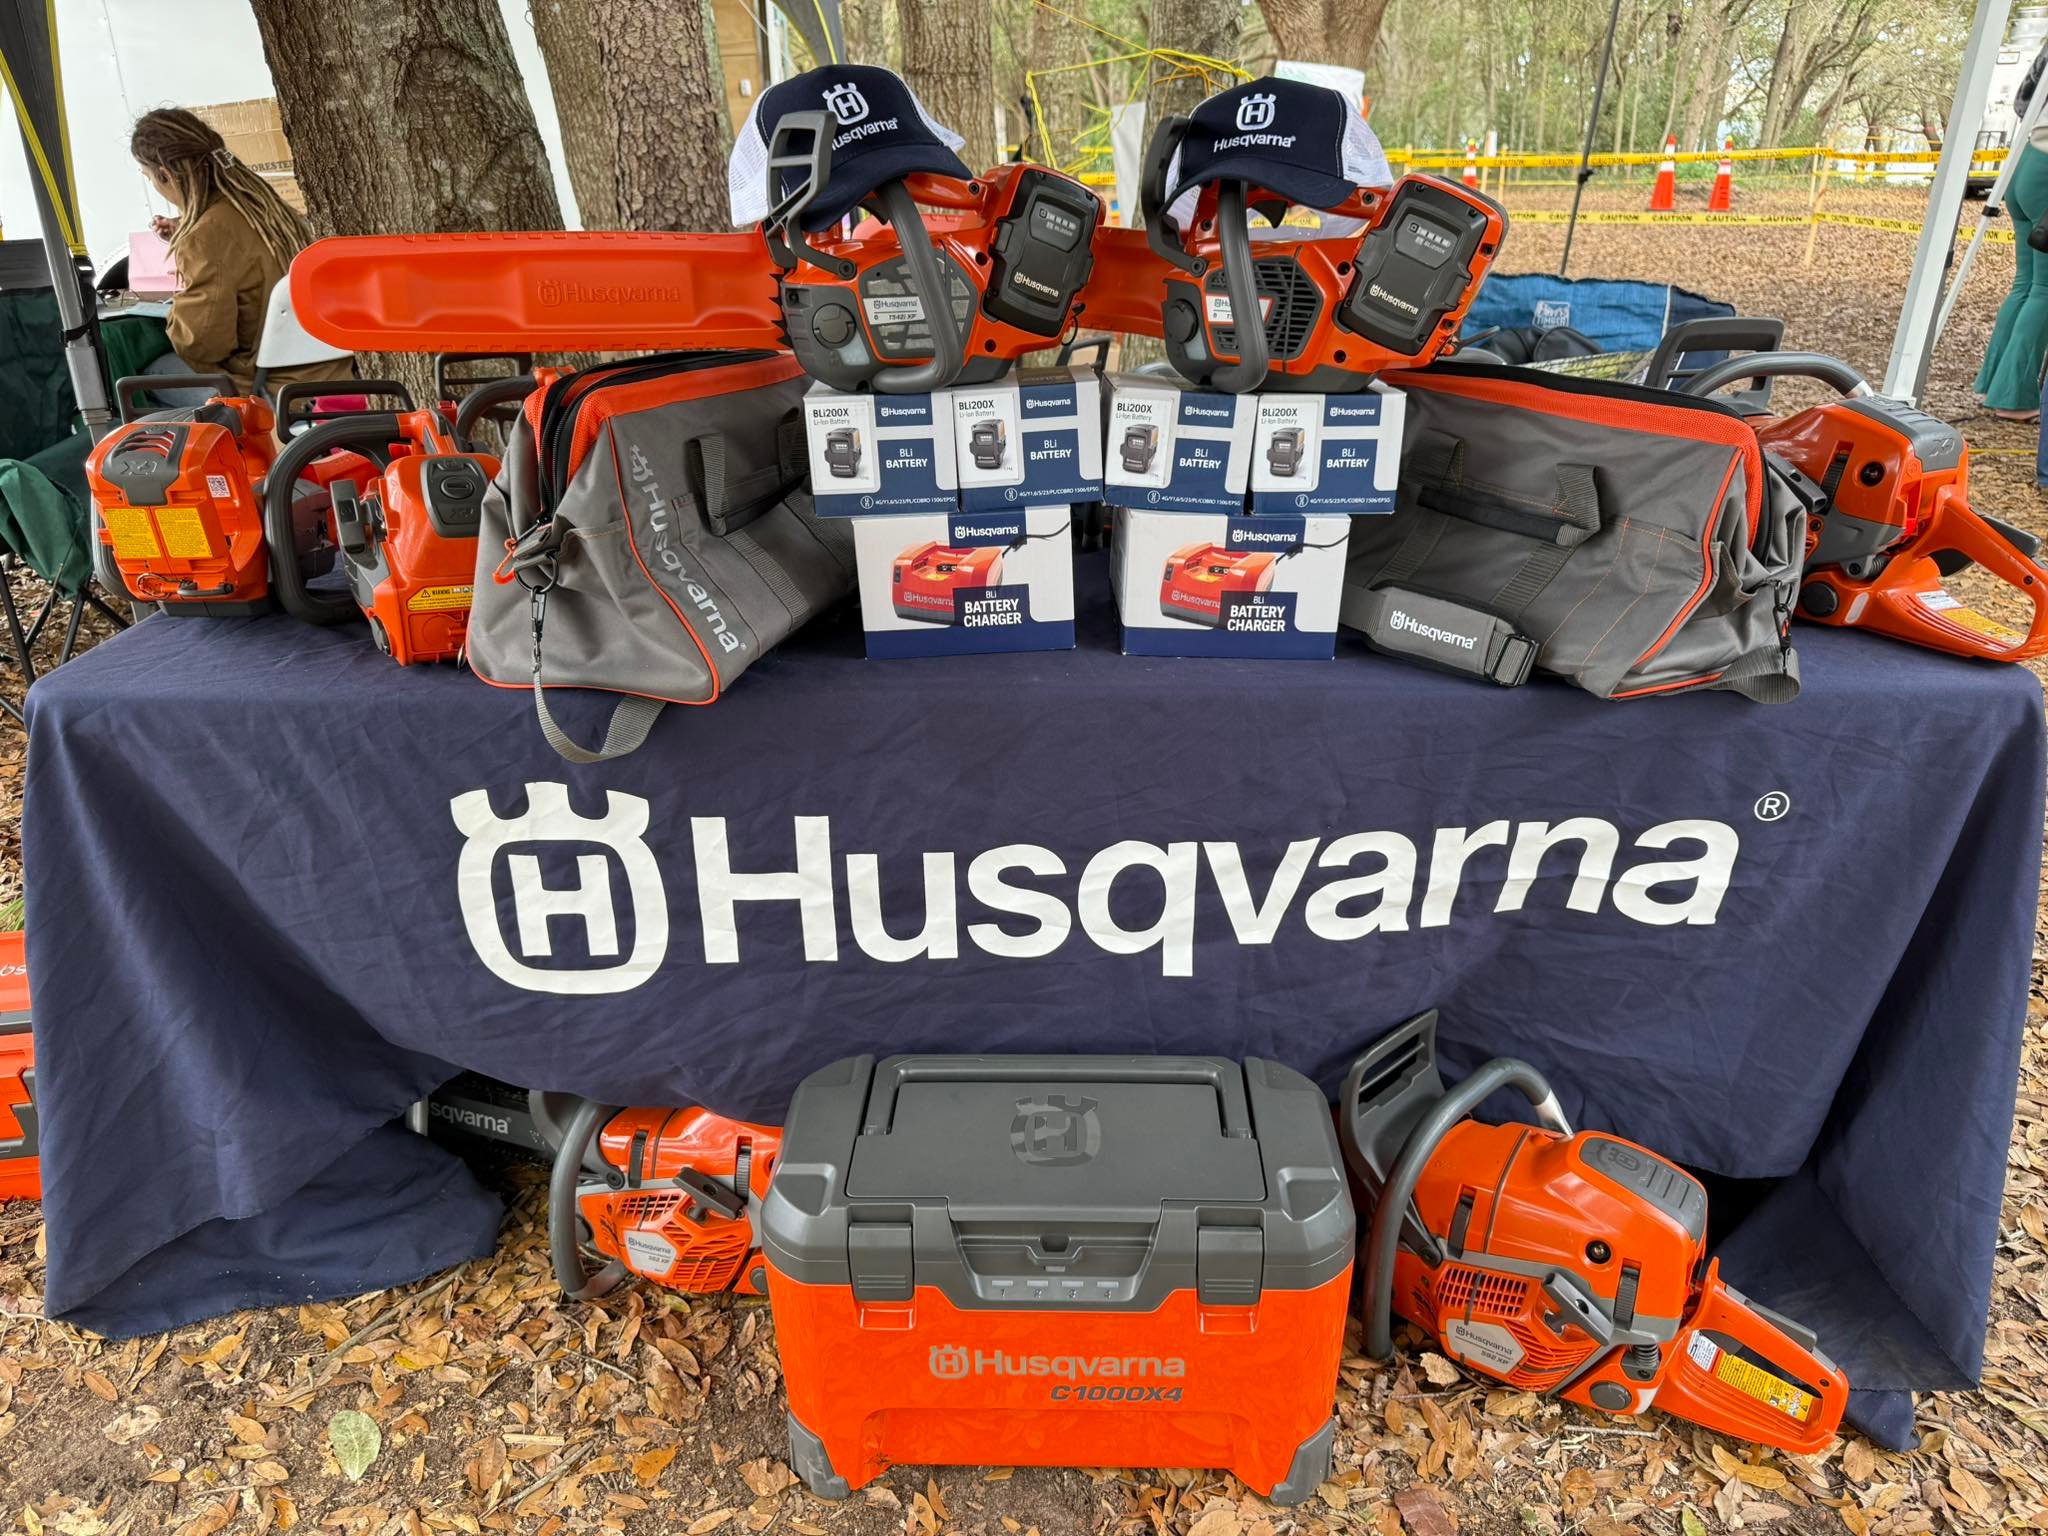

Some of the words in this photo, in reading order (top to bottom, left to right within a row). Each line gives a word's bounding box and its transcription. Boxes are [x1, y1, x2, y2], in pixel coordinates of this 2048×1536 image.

[831, 117, 896, 151] usqvarna
[1213, 133, 1293, 153] Husqvarna
[1652, 214, 1692, 222] CAUTION
[1705, 214, 1747, 222] CAUTION
[1855, 217, 1875, 225] CAUTION
[1880, 219, 1902, 229] CAUTION
[1021, 275, 1060, 298] Husqvarna
[564, 283, 681, 305] Husqvarna
[880, 300, 918, 308] Husqvarna
[1377, 289, 1420, 315] Husqvarna
[958, 400, 995, 411] BLi200X
[1034, 398, 1071, 408] Husqvarna
[1116, 402, 1153, 414] BLi200X
[813, 408, 850, 418] BLi200X
[889, 407, 926, 416] Husqvarna
[975, 410, 995, 418] Battery
[1192, 407, 1229, 417] Husqvarna
[1262, 407, 1298, 417] BLi200X
[1337, 407, 1375, 417] Husqvarna
[829, 417, 850, 426] Battery
[1131, 414, 1152, 422] Battery
[1276, 417, 1297, 425] Battery
[1044, 439, 1057, 449] BLi
[899, 448, 913, 458] BLi
[1030, 449, 1072, 461] BATTERY
[1341, 448, 1356, 457] BLi
[885, 458, 928, 469] BATTERY
[1179, 458, 1222, 469] BATTERY
[1326, 458, 1370, 469] BATTERY
[965, 525, 1019, 537] Husqvarna
[1244, 530, 1297, 543] Husqvarna
[639, 482, 740, 655] Husqvarna
[985, 590, 997, 599] BLi
[1253, 596, 1265, 605] BLi
[964, 599, 1020, 614] BATTERY
[1230, 605, 1286, 619] BATTERY
[963, 612, 1022, 628] CHARGER
[1227, 618, 1286, 632] CHARGER
[1403, 616, 1475, 650] Husqvarna
[688, 815, 1740, 978] Husqvarna
[635, 1240, 672, 1254] Husqvarna
[1465, 1330, 1513, 1355] Husqvarna
[975, 1348, 1186, 1381] Husqvarna
[1050, 1384, 1184, 1403] C1000X4
